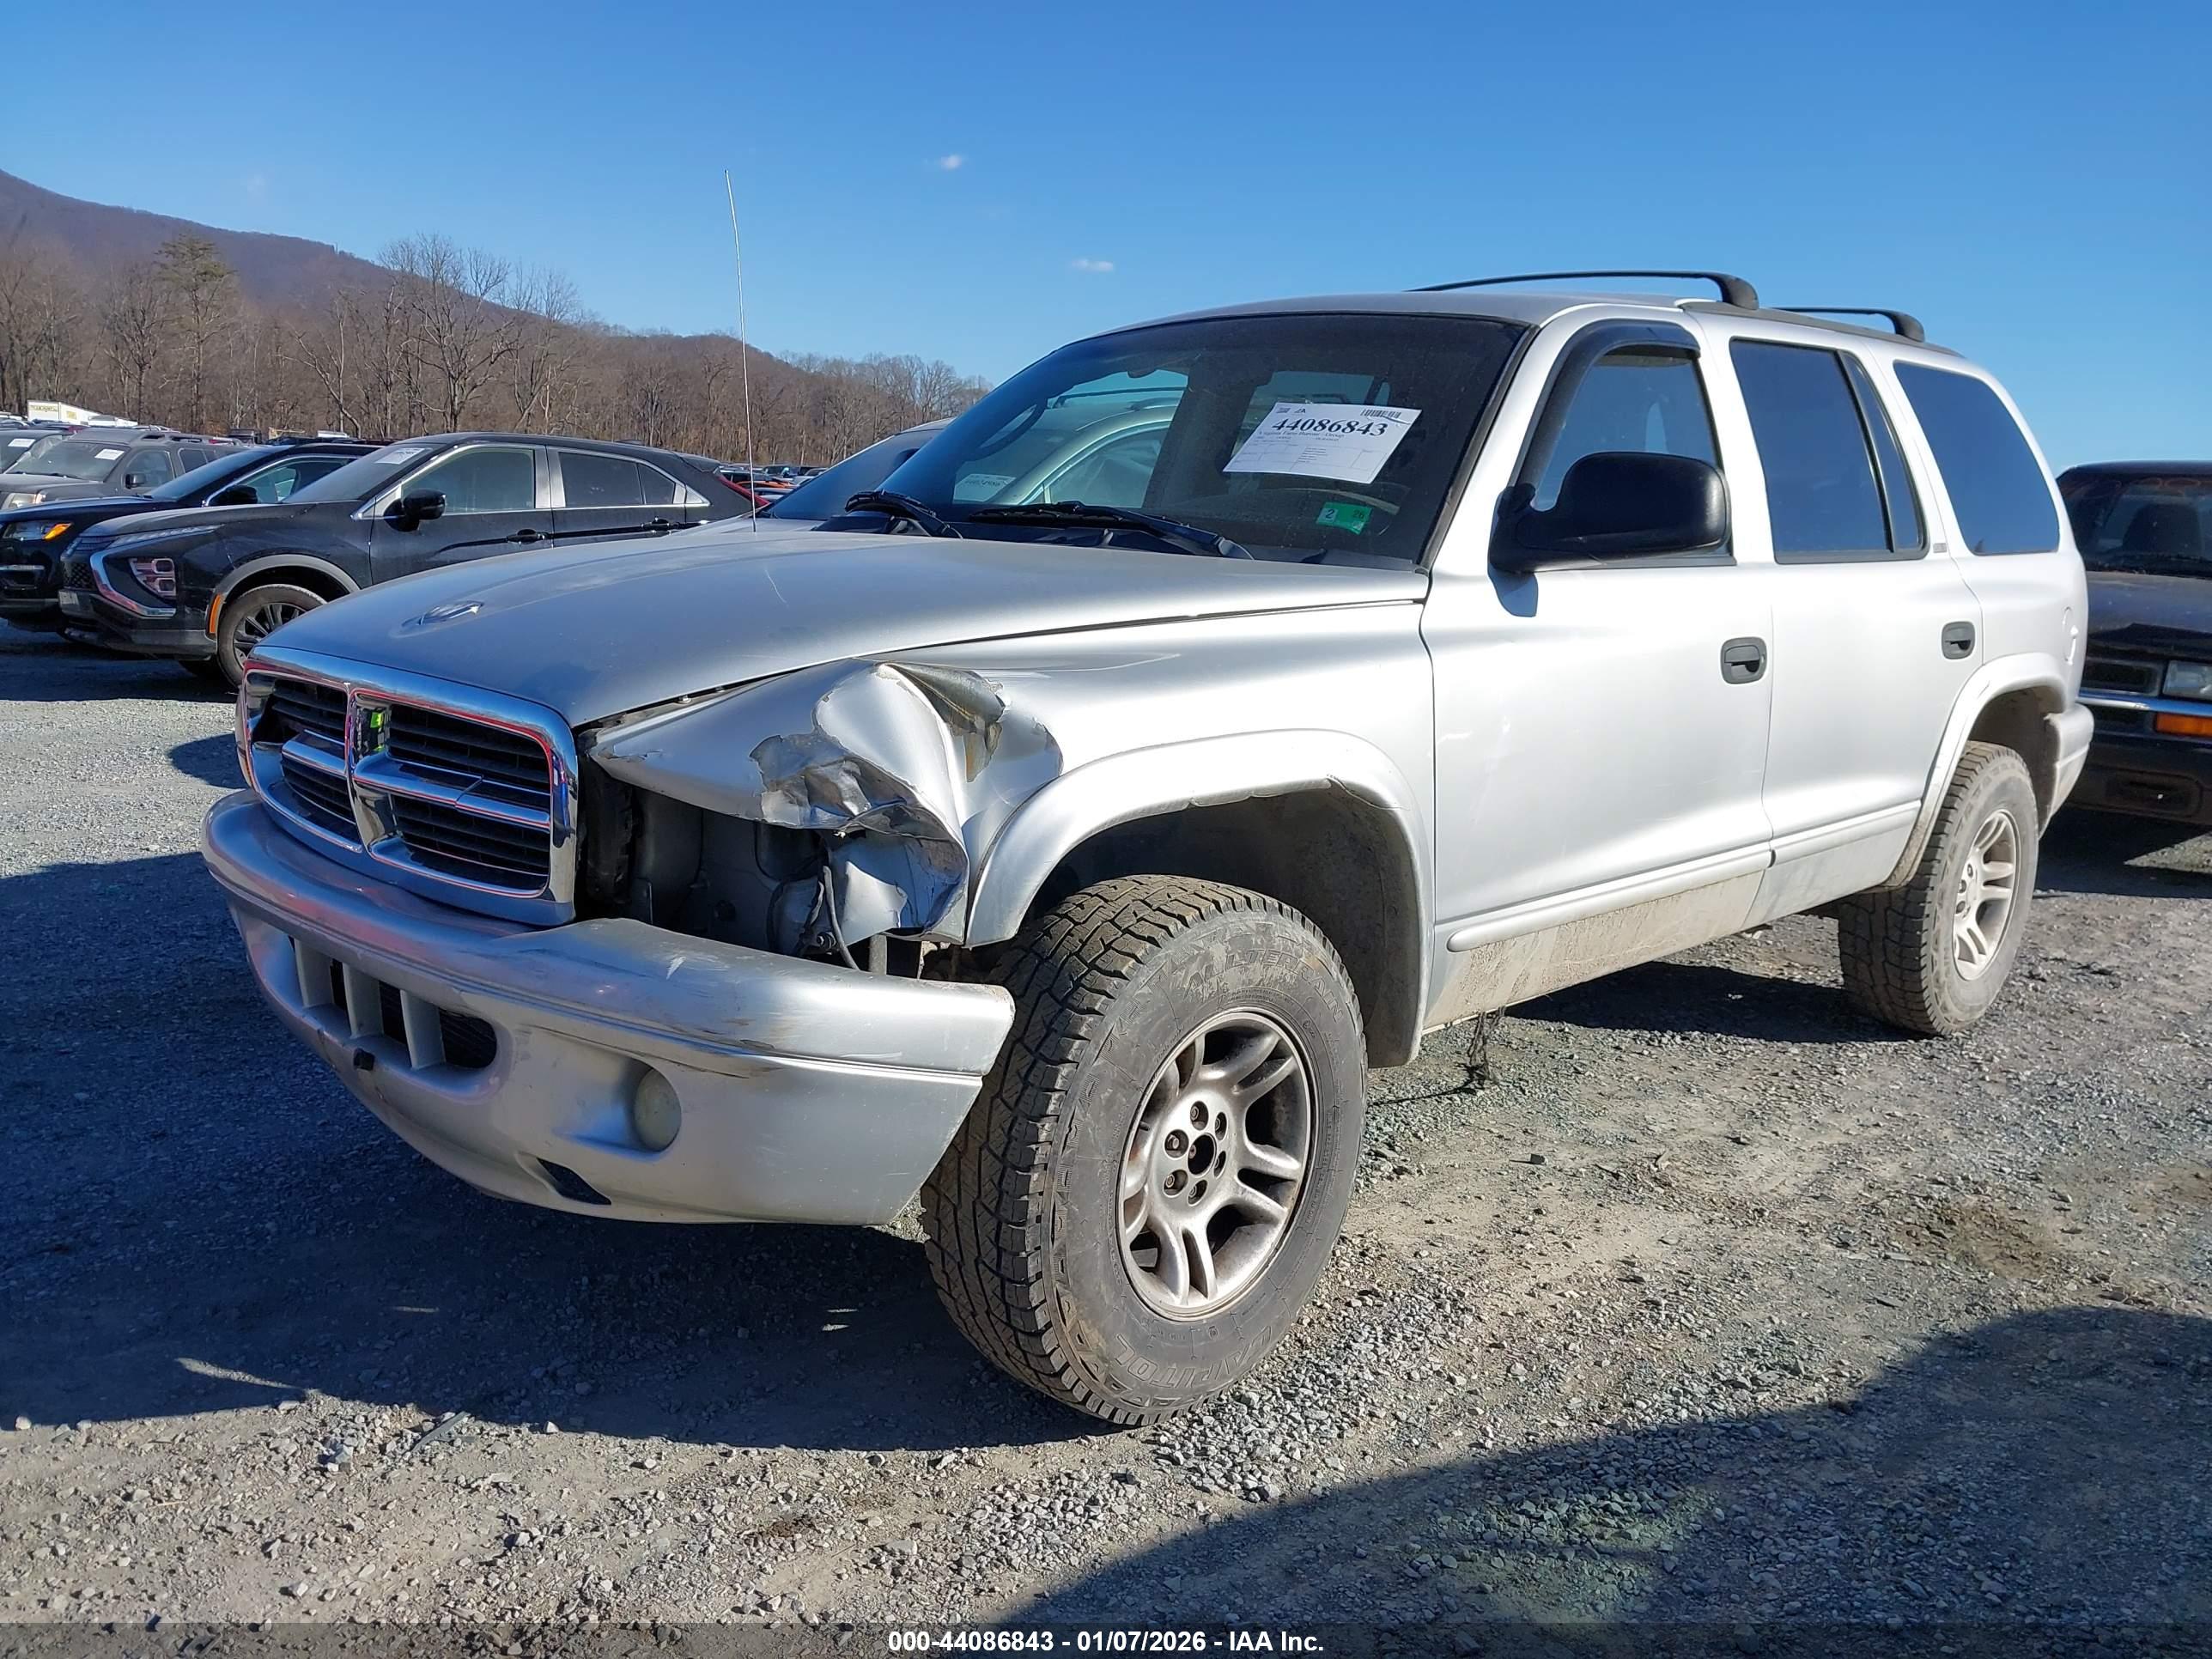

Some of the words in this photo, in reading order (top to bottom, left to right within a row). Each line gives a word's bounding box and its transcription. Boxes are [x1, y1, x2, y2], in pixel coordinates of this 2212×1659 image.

[1271, 417, 1389, 437] 44086843
[1325, 508, 1334, 520] 2
[1114, 1325, 1273, 1389] CAPITOL
